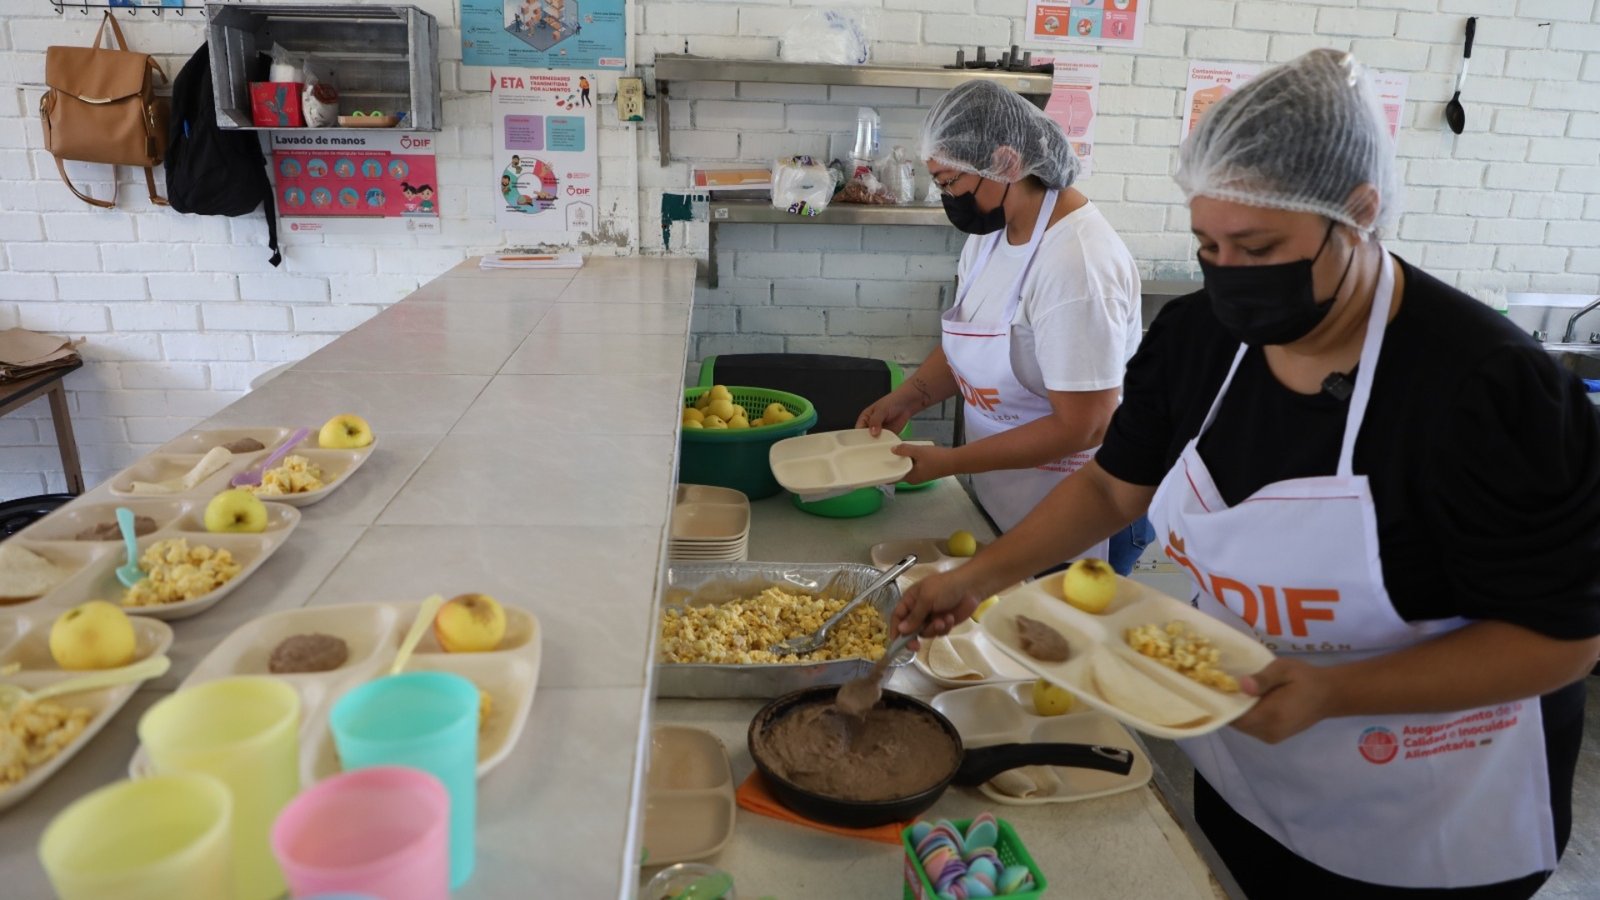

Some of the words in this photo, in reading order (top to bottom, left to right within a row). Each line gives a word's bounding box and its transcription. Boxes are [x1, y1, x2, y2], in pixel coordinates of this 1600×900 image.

[1038, 8, 1044, 16] 3
[1105, 12, 1112, 20] 5
[500, 77, 524, 89] ETA
[275, 135, 312, 145] Lavado
[315, 135, 327, 145] de
[330, 137, 366, 145] manos
[413, 139, 430, 147] DIF
[1208, 573, 1340, 637] DIF
[1403, 710, 1494, 735] Aseguramiento
[1495, 705, 1511, 719] de
[1403, 732, 1447, 748] Calidad
[1458, 715, 1518, 736] Inocuidad
[1404, 739, 1476, 760] Alimentaria
